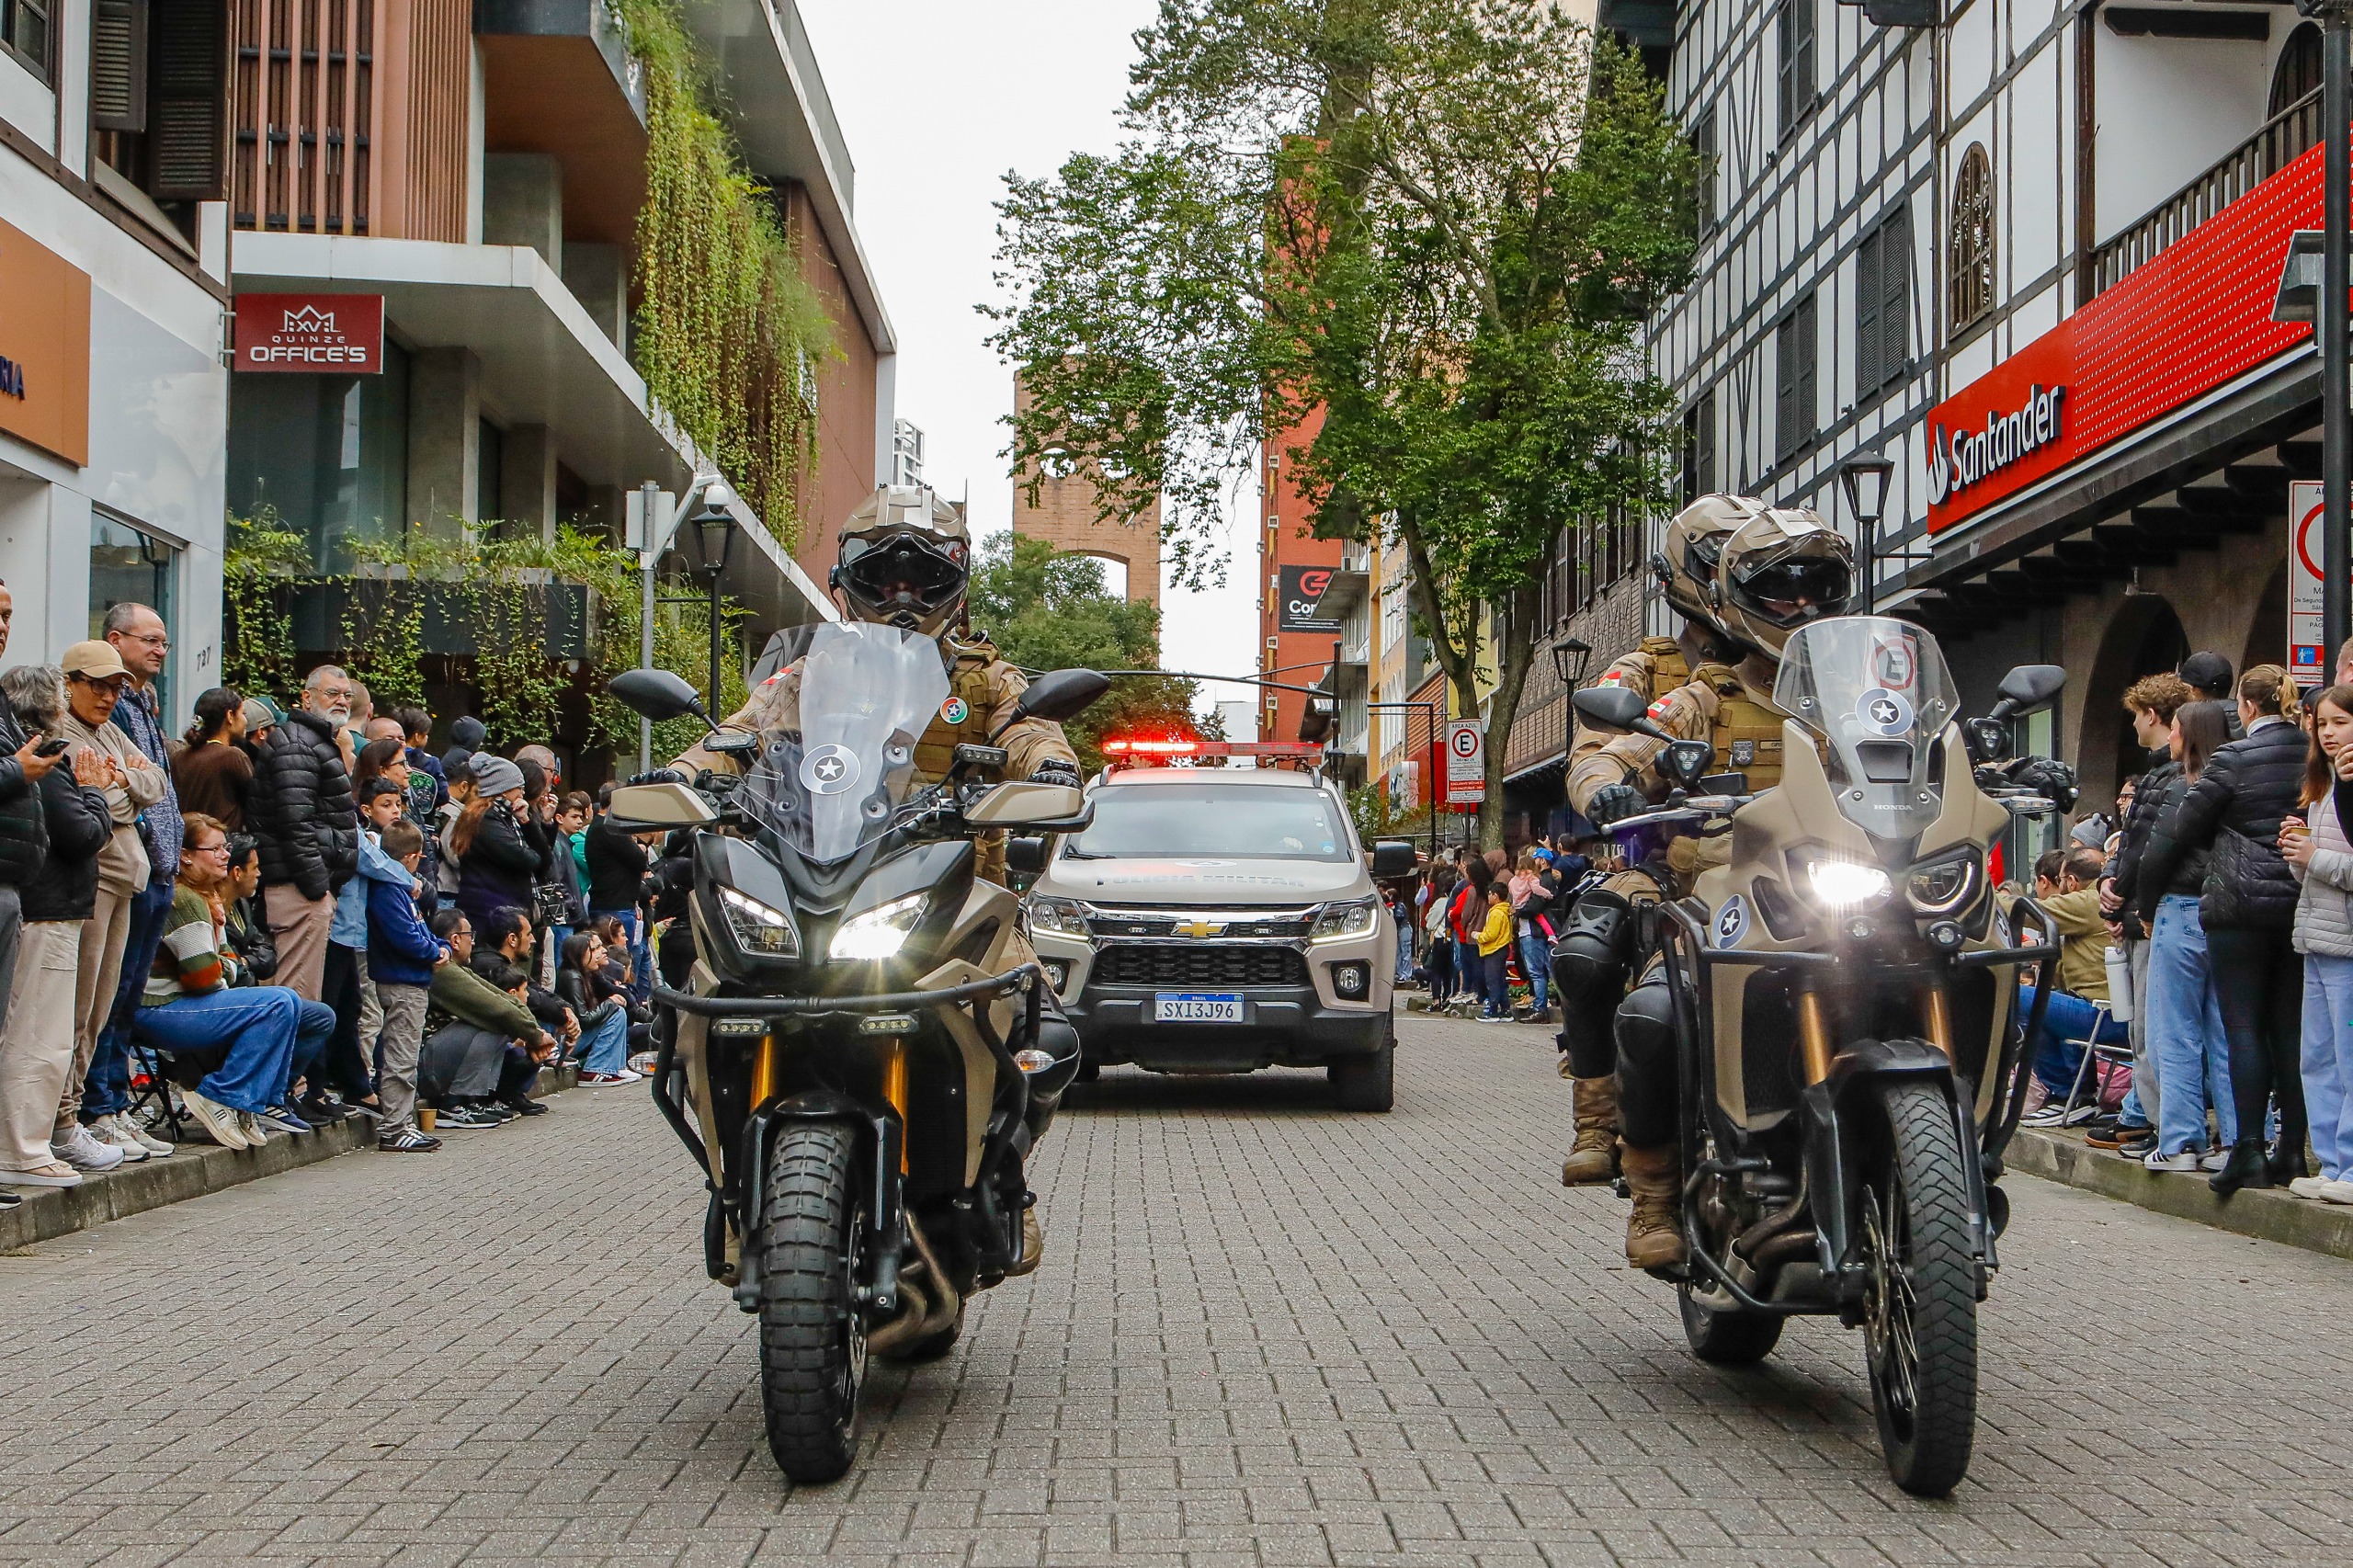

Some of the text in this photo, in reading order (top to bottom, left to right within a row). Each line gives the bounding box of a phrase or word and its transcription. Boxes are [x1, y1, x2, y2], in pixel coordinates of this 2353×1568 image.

[250, 346, 367, 362] OFFICE'S
[1951, 384, 2063, 492] Santander
[197, 645, 211, 672] 727
[1460, 734, 1471, 752] E
[1203, 875, 1305, 888] MILITAR
[1164, 1002, 1233, 1018] SXI3J96
